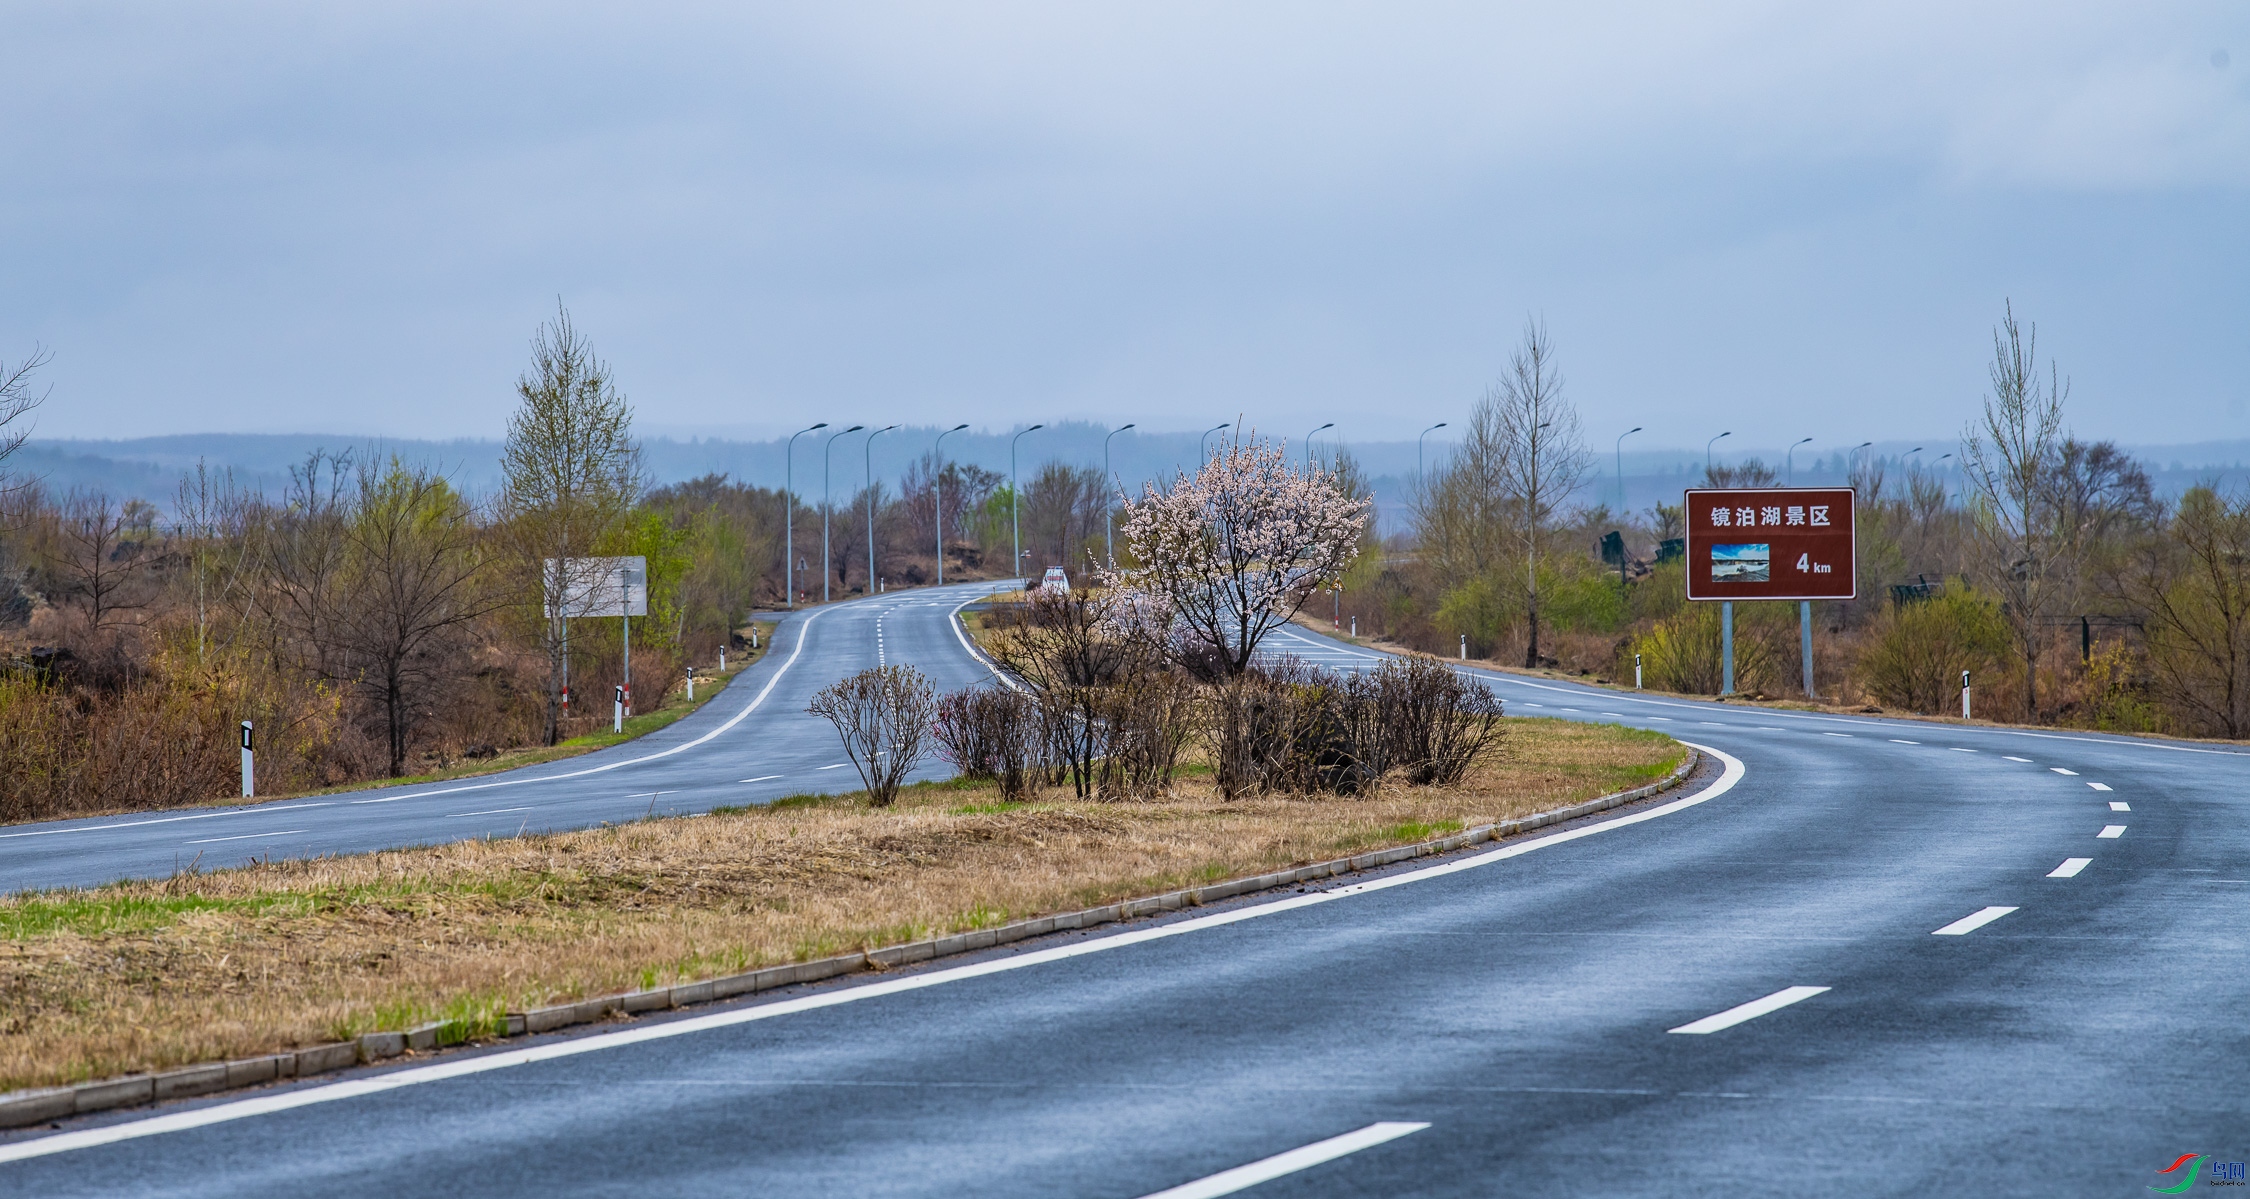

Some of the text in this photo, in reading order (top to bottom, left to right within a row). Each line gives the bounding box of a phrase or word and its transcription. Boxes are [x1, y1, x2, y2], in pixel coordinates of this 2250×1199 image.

[1711, 506, 1830, 526] 镜泊湖景区
[1797, 553, 1831, 573] 4 km
